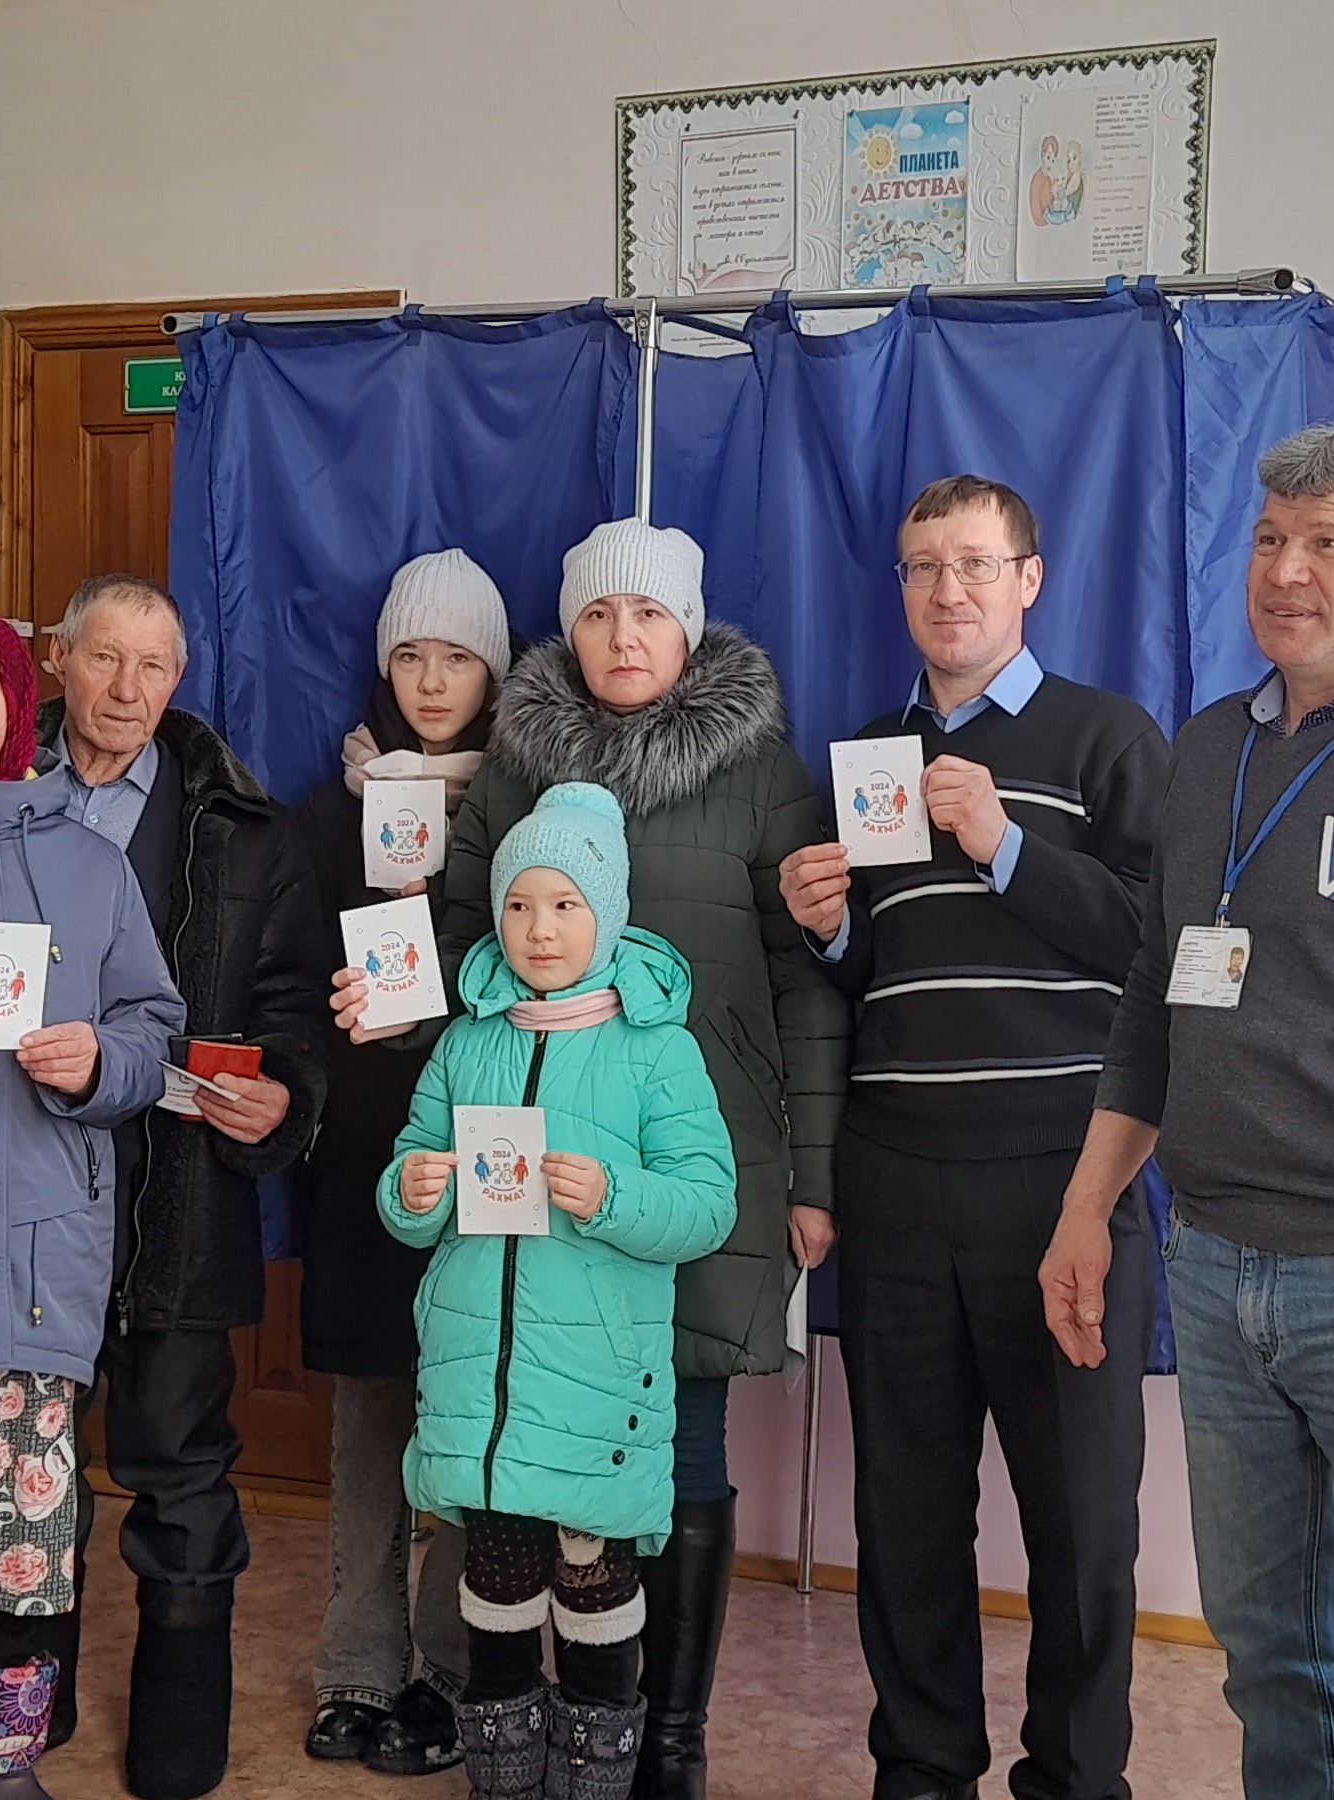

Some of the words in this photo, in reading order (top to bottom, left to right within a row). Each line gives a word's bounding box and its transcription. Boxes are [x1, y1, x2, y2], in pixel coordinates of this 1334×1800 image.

[900, 150, 959, 173] ПЛАНЕТА
[860, 176, 959, 204] ДЕТСТВА
[870, 782, 890, 791] 2024
